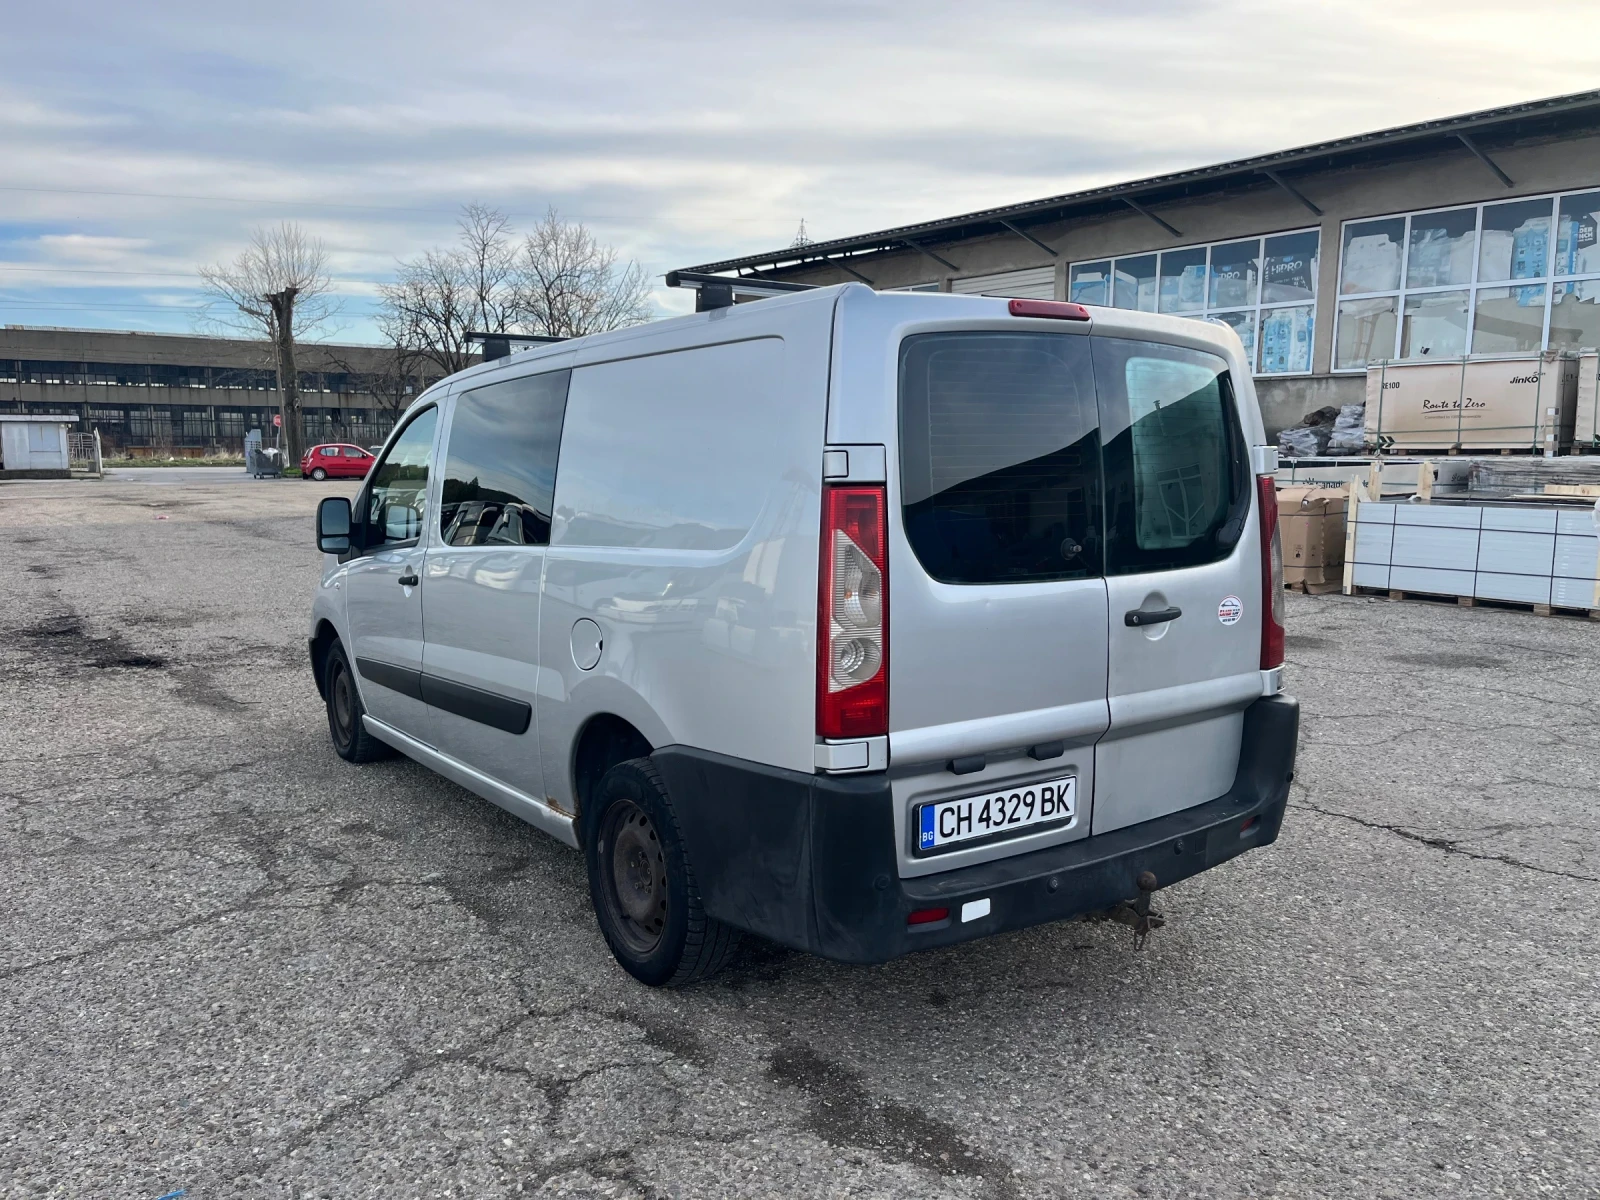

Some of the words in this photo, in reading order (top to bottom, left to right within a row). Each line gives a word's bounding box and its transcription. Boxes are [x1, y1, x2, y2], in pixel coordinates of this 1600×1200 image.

[1423, 399, 1449, 410] Route
[1452, 400, 1462, 409] to
[1464, 397, 1486, 408] Zero
[939, 802, 972, 838] CH
[978, 790, 1036, 829] 4329
[1040, 783, 1071, 817] BK
[922, 831, 934, 842] BG
